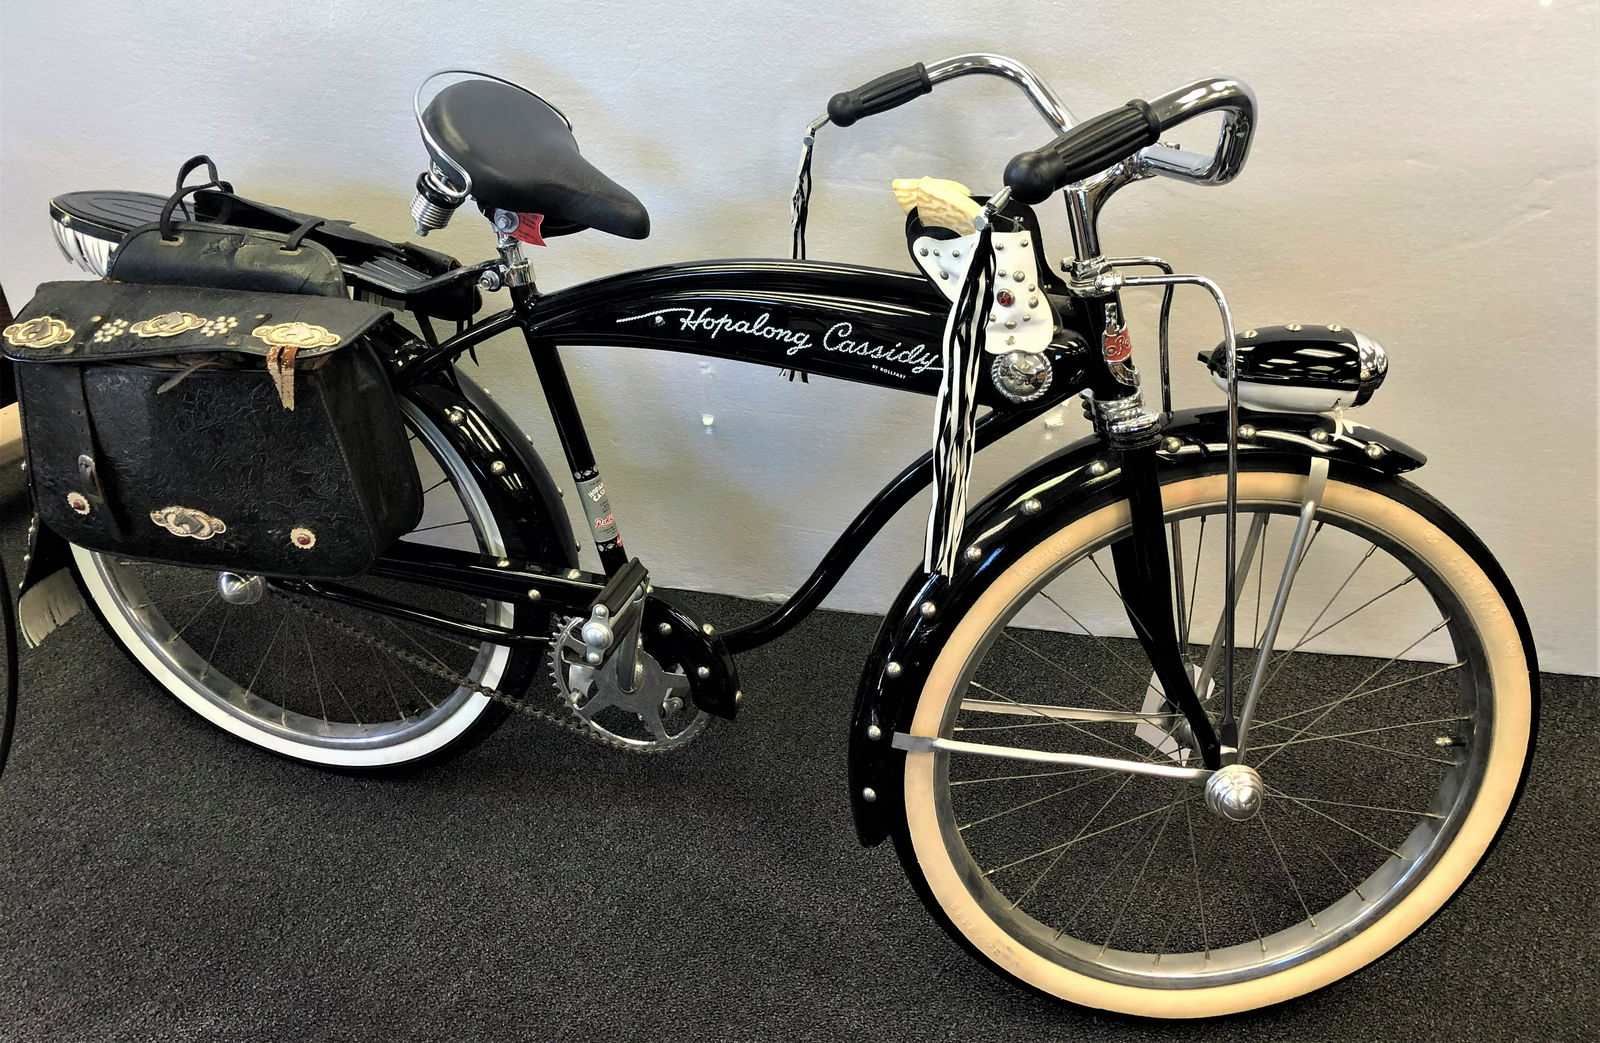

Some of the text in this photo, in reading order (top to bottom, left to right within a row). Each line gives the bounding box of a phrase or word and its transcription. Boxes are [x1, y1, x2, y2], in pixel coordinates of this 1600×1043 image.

[679, 307, 940, 374] Hopalong Cassidy
[879, 367, 907, 379] ROLLFAST
